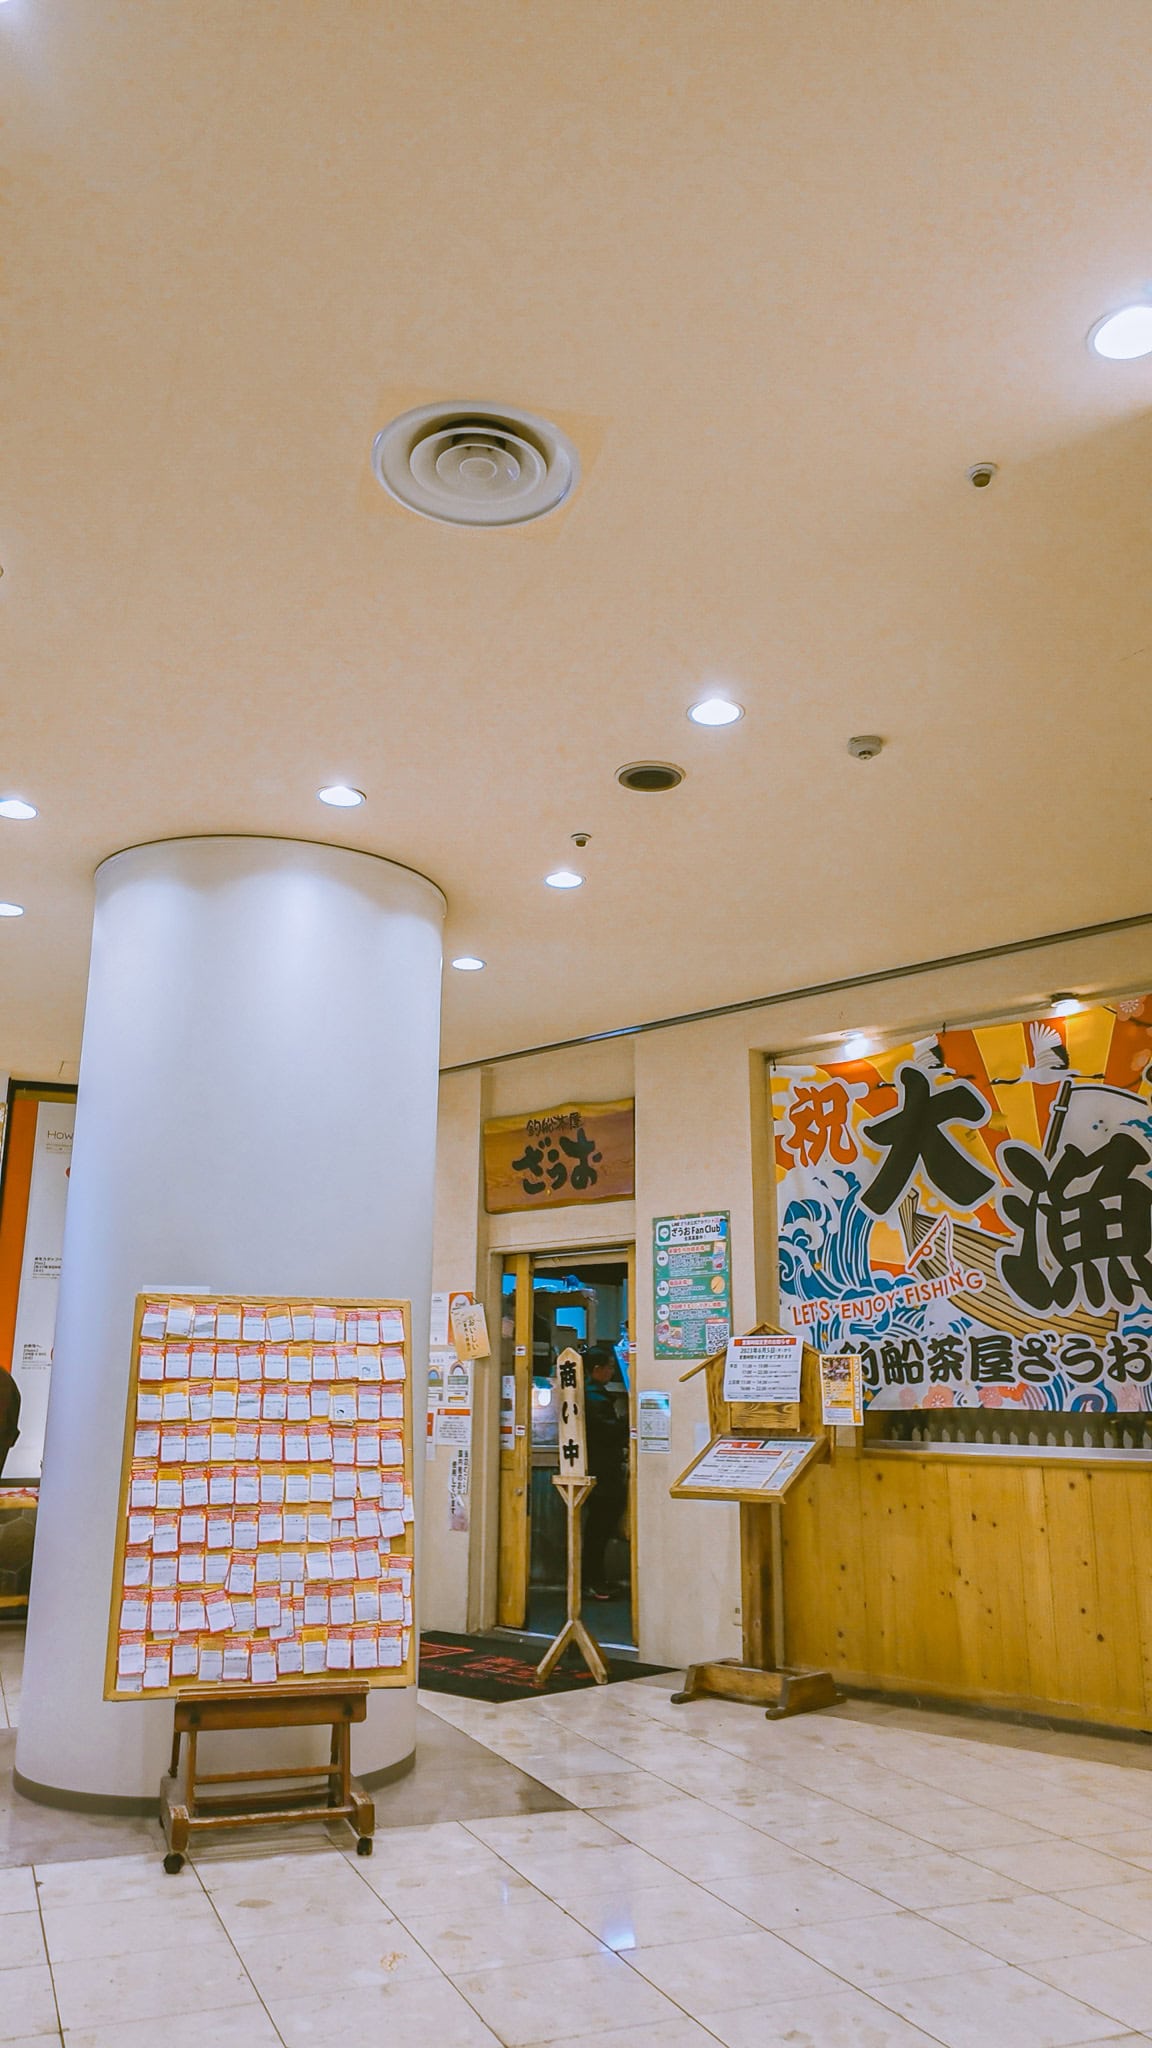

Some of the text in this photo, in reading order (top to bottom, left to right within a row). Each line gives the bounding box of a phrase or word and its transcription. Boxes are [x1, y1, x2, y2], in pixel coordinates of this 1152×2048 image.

[786, 1084, 858, 1168] 祝
[512, 1127, 602, 1195] ざうお
[691, 1226, 704, 1235] Fan
[704, 1223, 721, 1233] Club
[793, 1300, 830, 1326] LET'S
[905, 1272, 983, 1304] FISHING
[559, 1360, 579, 1467] 商い中
